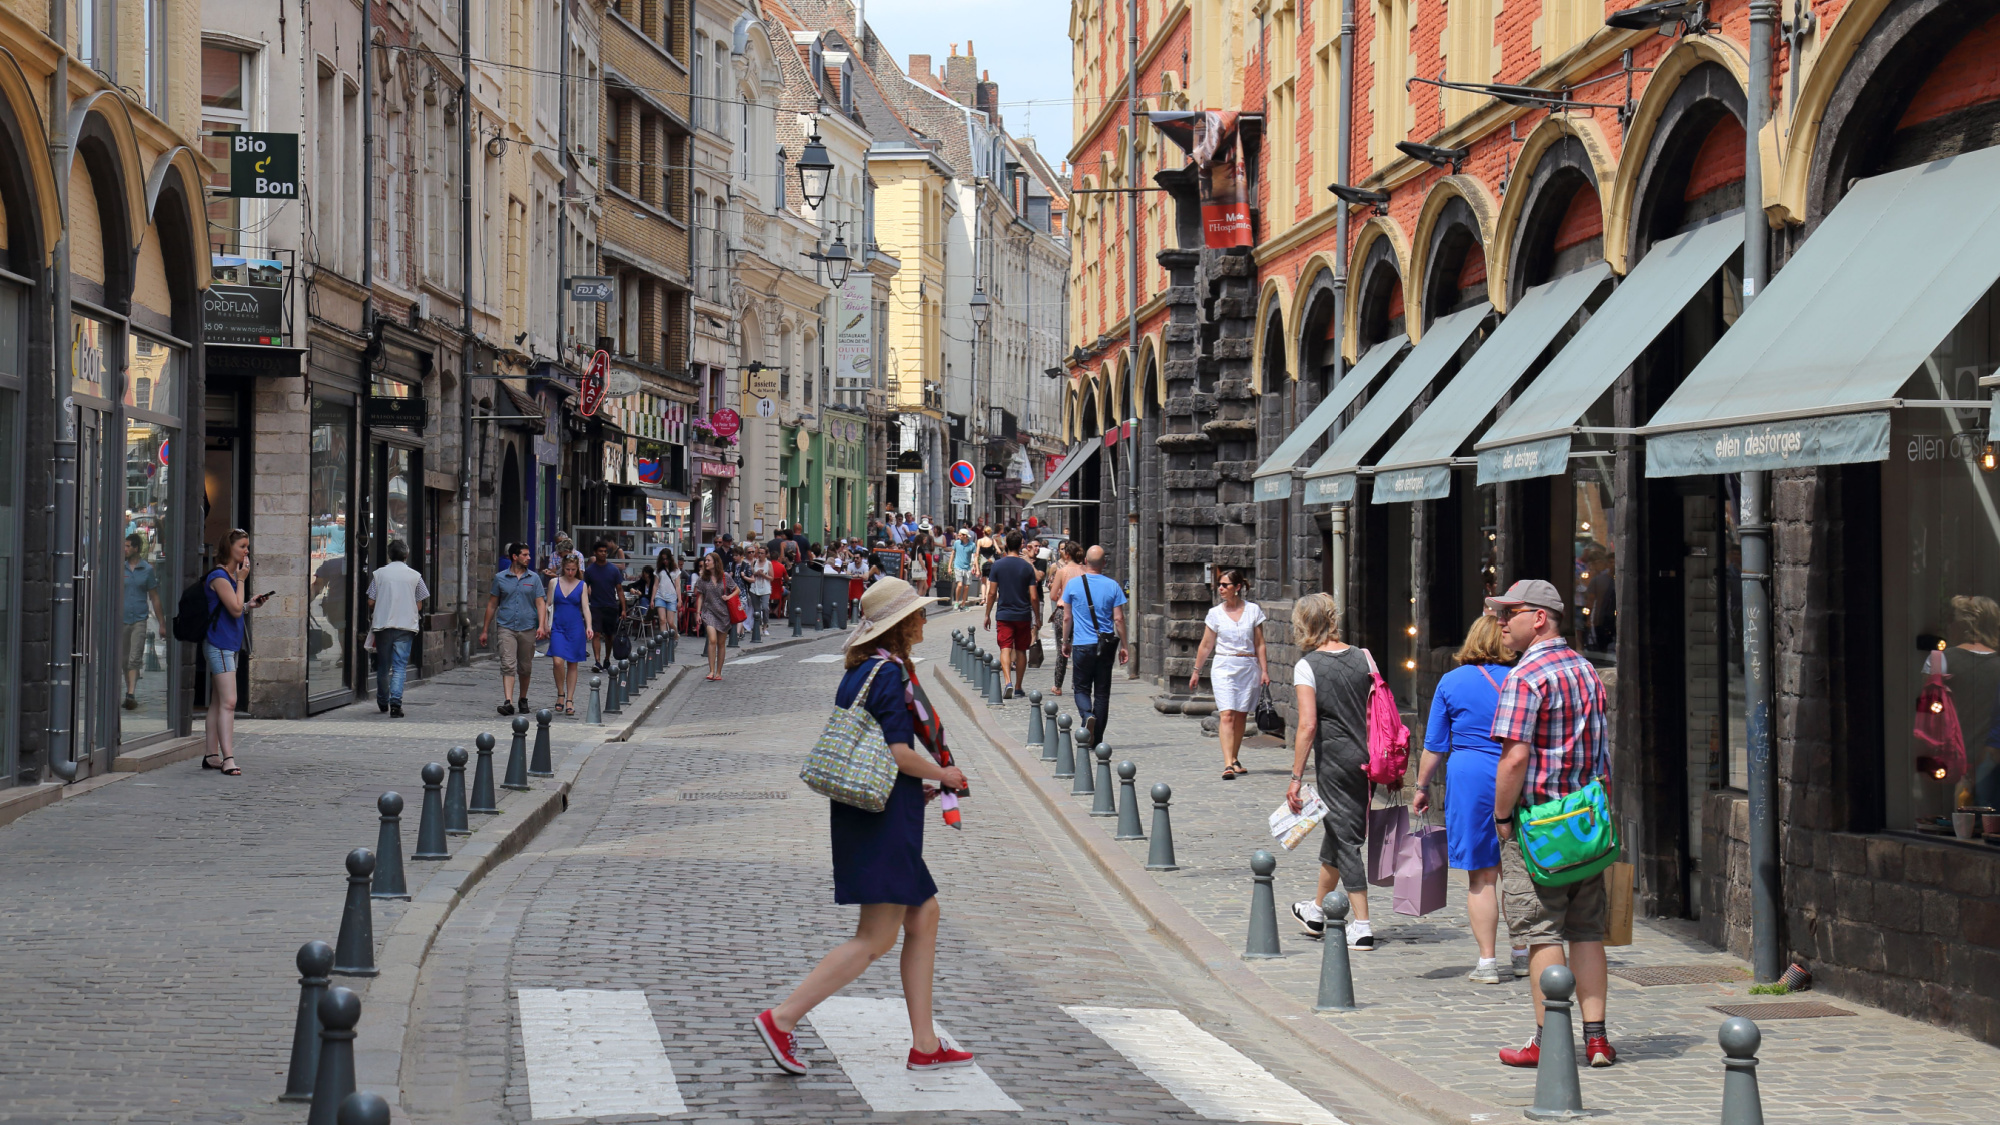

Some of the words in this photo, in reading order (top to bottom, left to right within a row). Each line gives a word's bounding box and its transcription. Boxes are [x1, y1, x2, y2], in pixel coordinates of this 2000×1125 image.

[235, 136, 267, 152] Bio
[255, 177, 294, 194] Bon
[576, 286, 594, 294] FDJ
[204, 300, 259, 313] ORDFLAM
[213, 323, 224, 331] 09
[80, 332, 101, 385] Bon
[207, 355, 281, 370] CH&SODA
[1716, 433, 1740, 458] ellen
[1744, 427, 1801, 460] desforges
[1908, 434, 1945, 462] ellen
